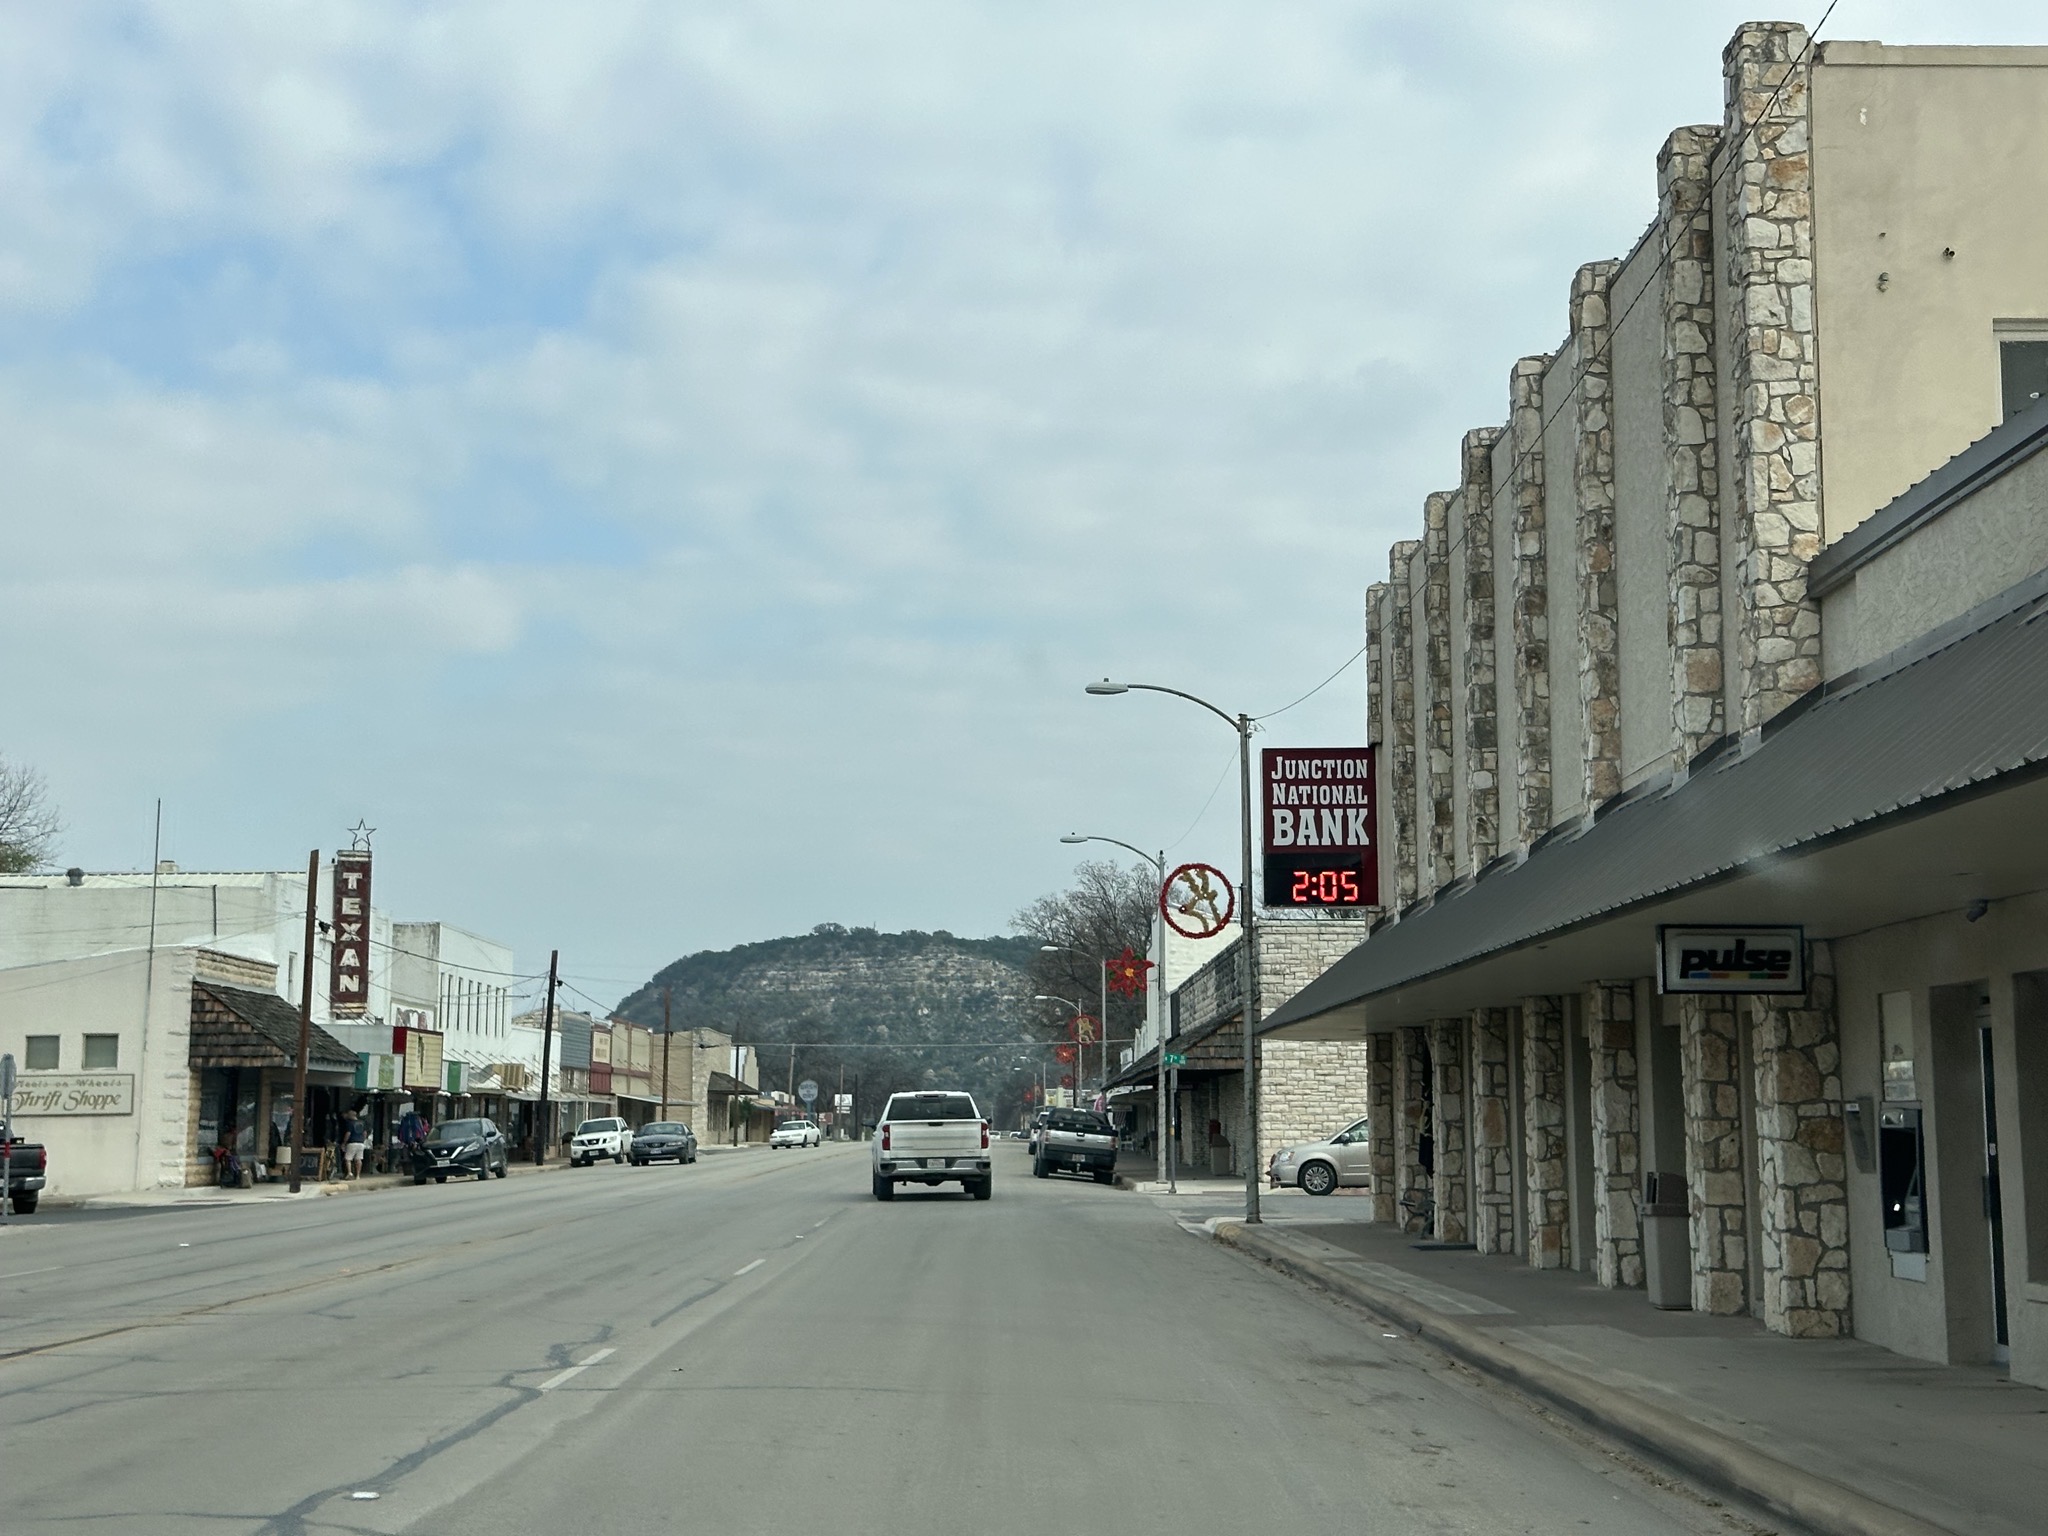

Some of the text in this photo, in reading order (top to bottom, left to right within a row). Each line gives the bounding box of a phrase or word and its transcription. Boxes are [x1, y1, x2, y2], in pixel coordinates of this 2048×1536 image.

[1271, 756, 1368, 780] JUNCTION
[1272, 783, 1368, 805] NATIONAL
[1272, 808, 1370, 846] BANK
[1292, 871, 1359, 902] 2:05
[338, 872, 363, 993] TEXAN
[1679, 938, 1792, 979] pulse
[11, 1089, 122, 1112] Thrift Shoppe
